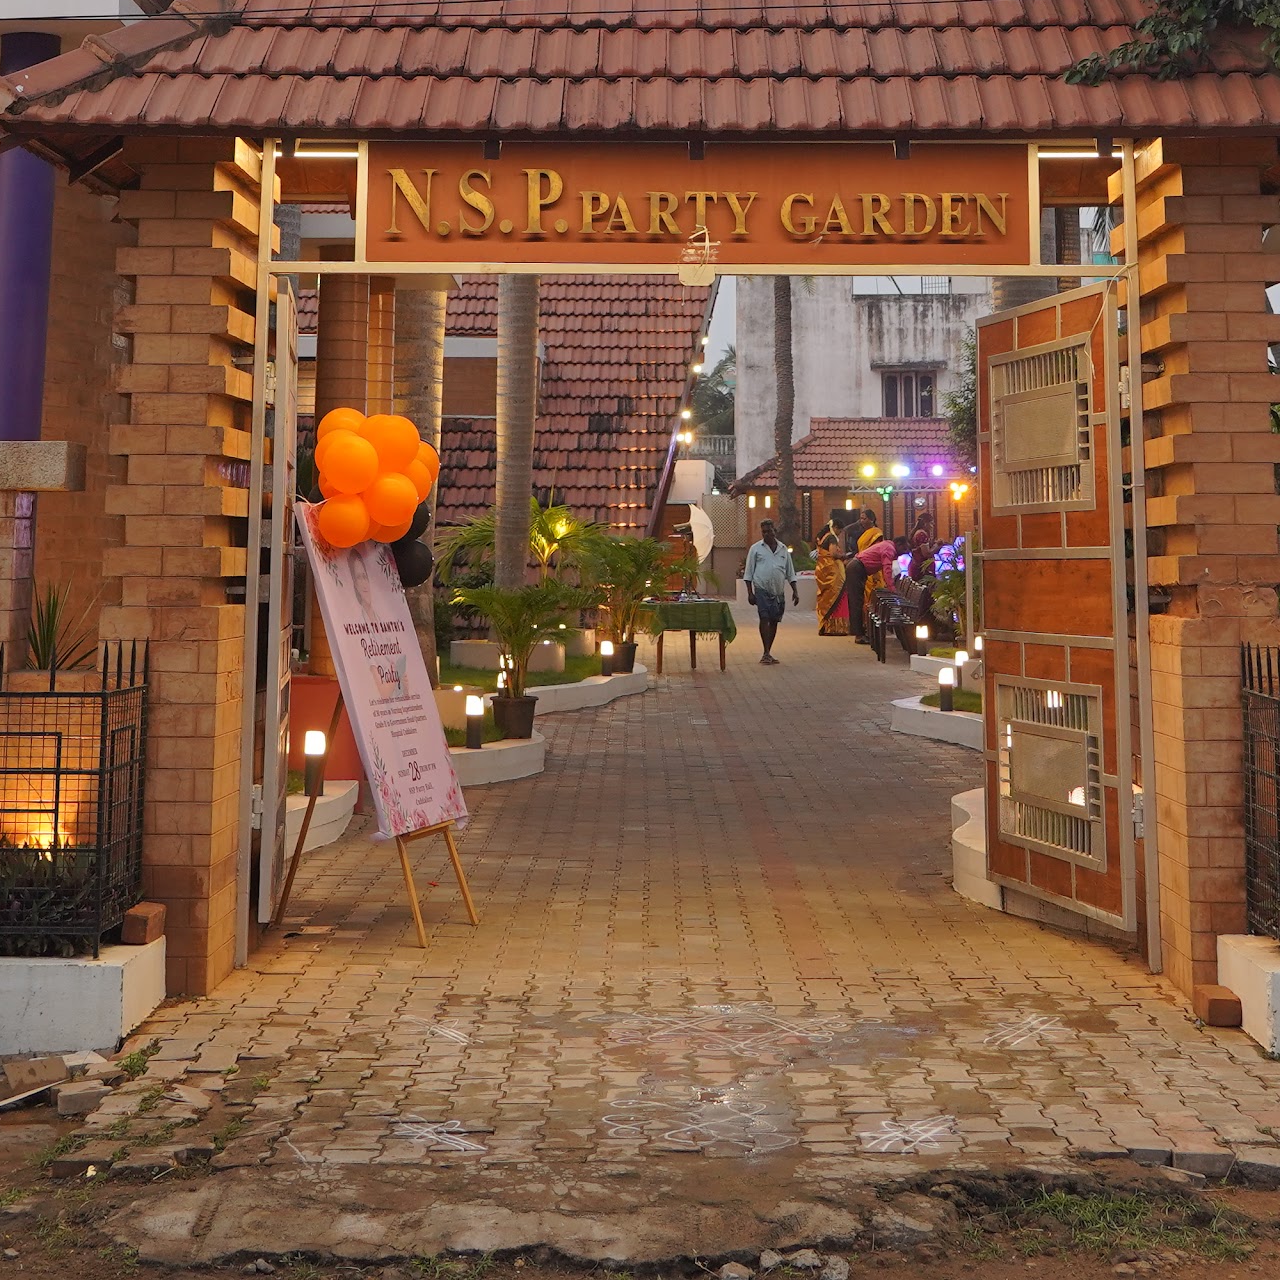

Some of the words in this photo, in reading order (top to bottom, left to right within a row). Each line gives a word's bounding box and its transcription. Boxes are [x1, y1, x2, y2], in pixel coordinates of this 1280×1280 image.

[578, 191, 758, 235] PARTY
[780, 192, 1009, 236] GARDEN
[343, 623, 370, 635] WELCOME
[371, 622, 379, 633] TO
[360, 637, 402, 659] Retirement
[377, 664, 401, 690] Party
[409, 761, 421, 781] 28
